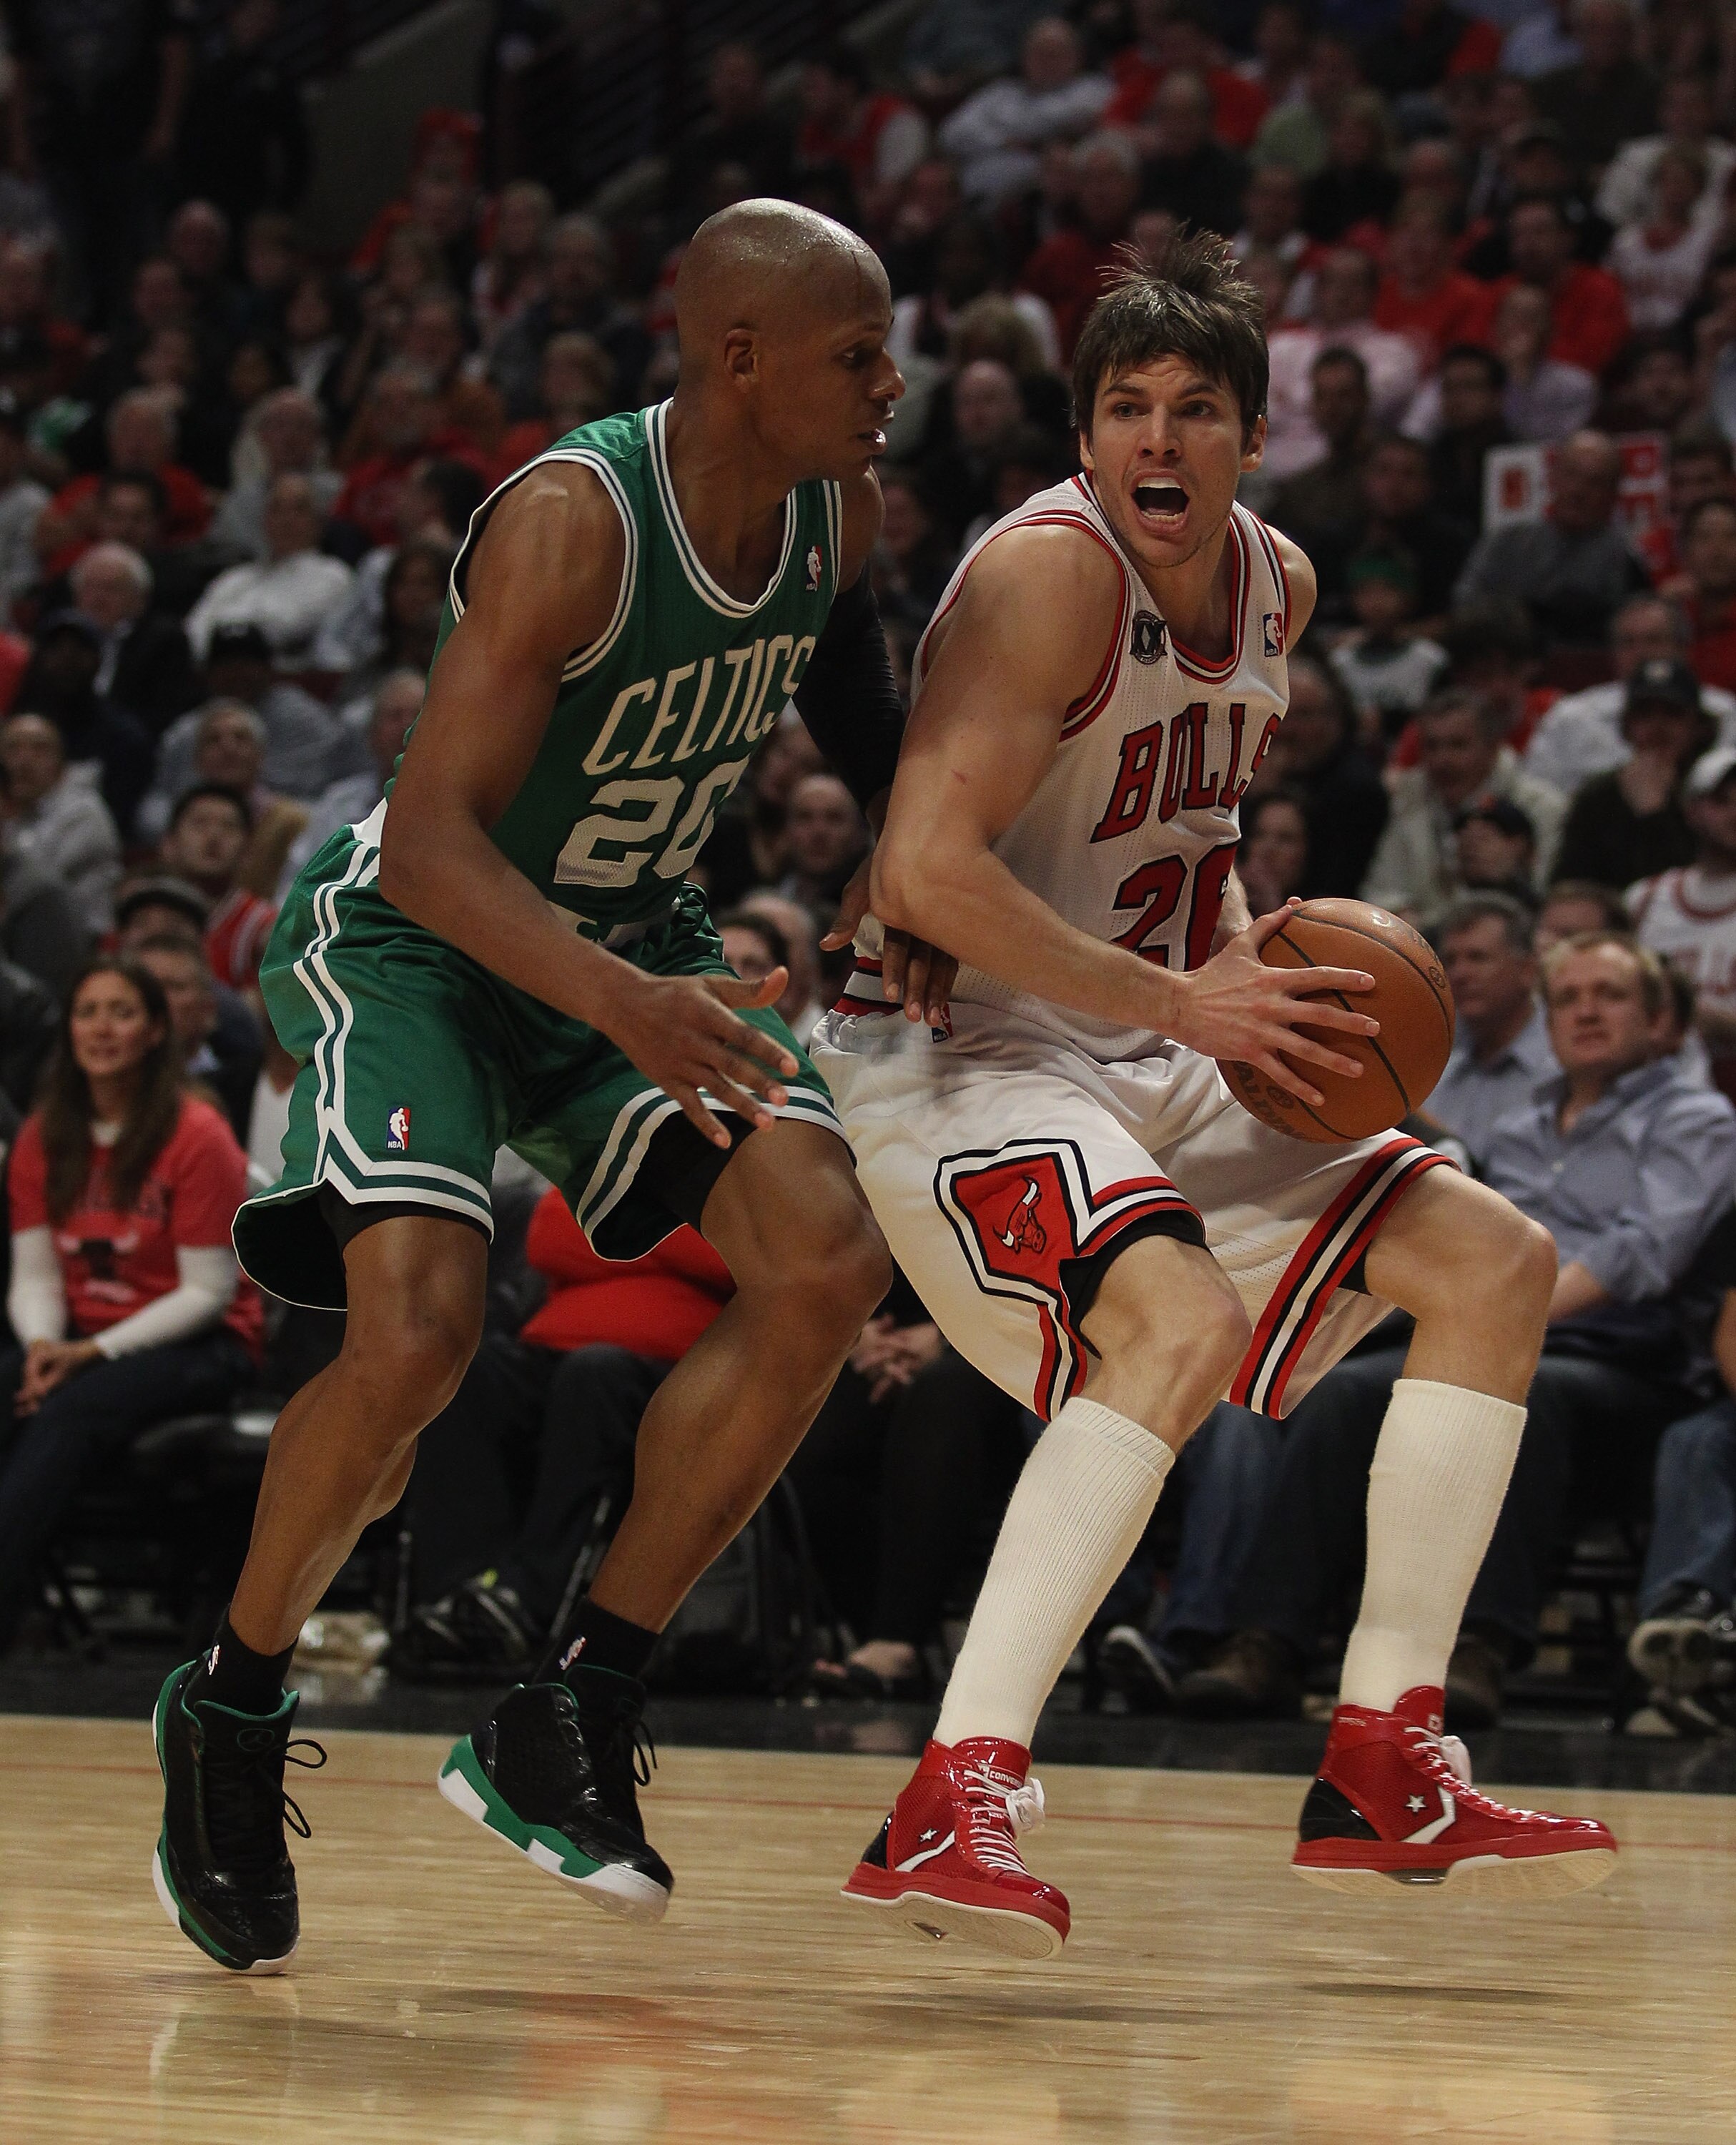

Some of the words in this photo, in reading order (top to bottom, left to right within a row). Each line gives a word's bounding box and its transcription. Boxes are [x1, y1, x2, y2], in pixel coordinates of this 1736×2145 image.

[581, 634, 816, 776] CELTICS
[1090, 702, 1281, 844] BULLS
[553, 753, 750, 888] 20
